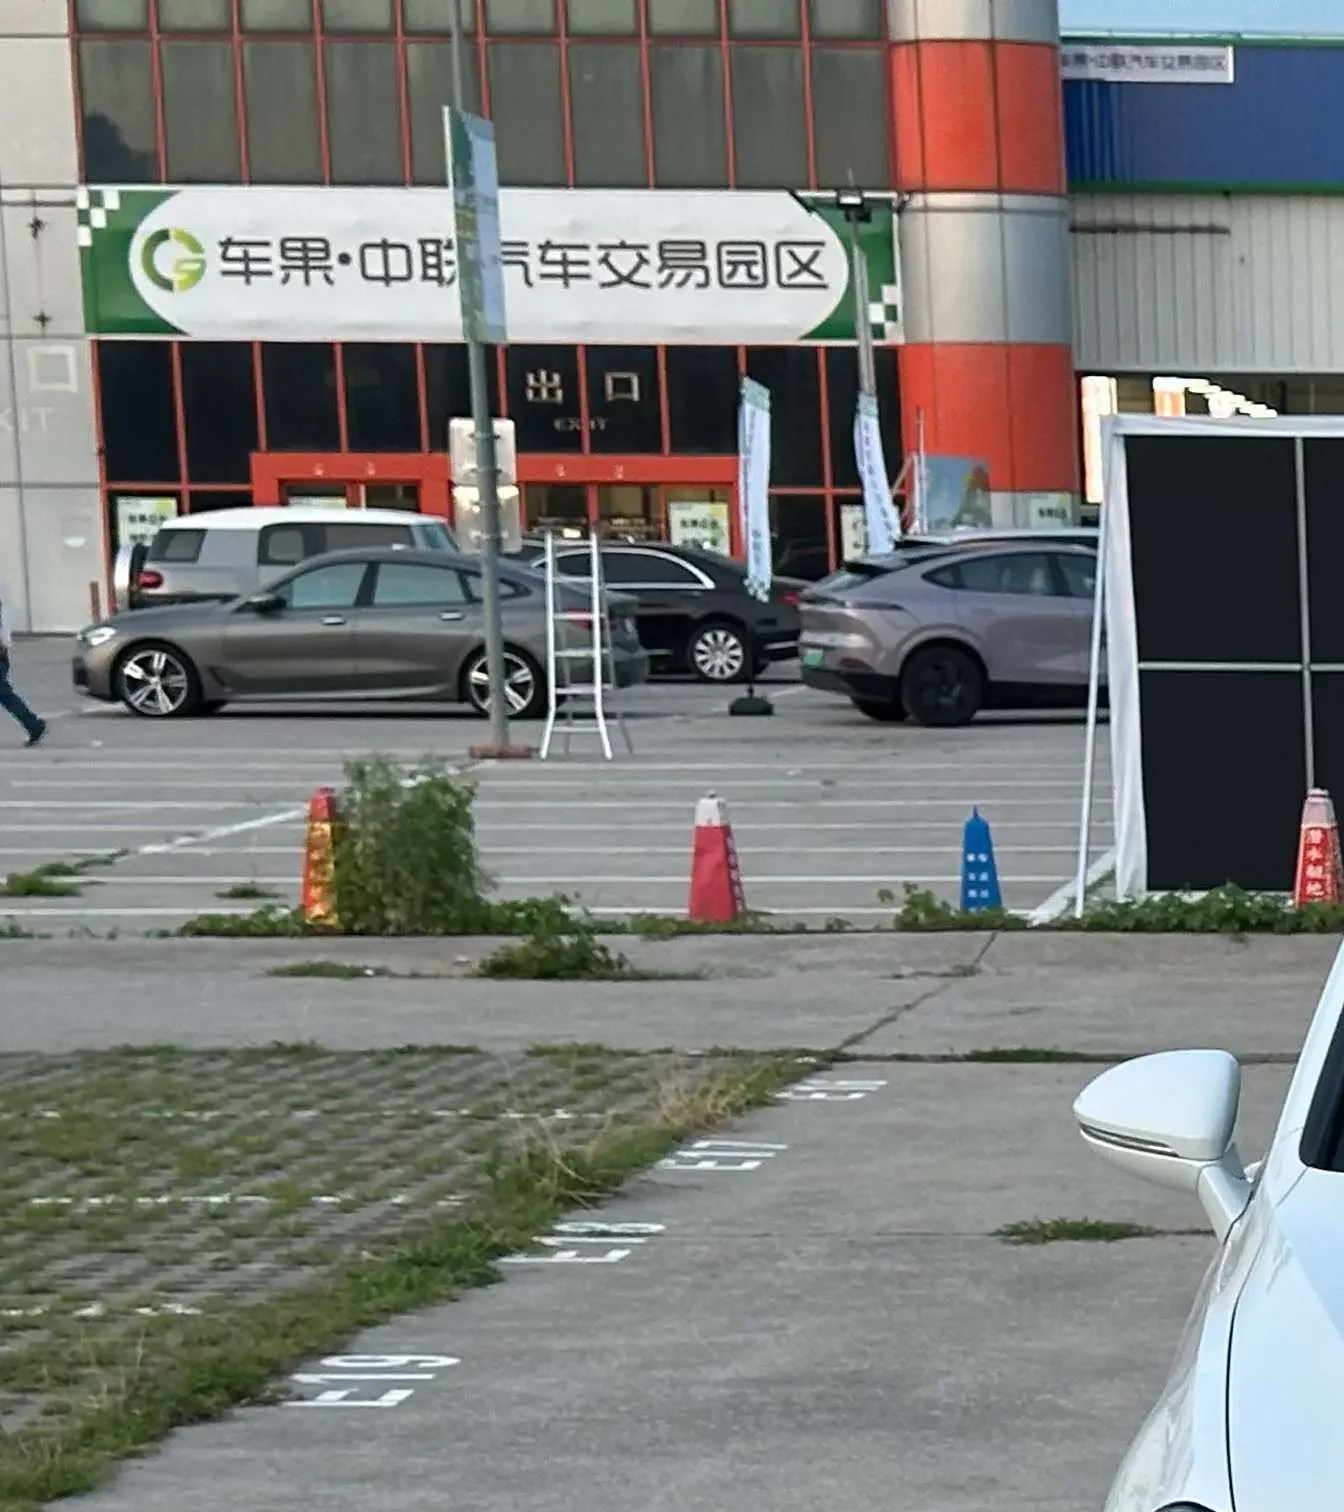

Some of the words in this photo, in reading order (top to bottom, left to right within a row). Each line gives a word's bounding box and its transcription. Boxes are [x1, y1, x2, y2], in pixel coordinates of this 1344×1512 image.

[526, 369, 642, 404] 出口
[553, 417, 609, 432] EXIT
[498, 1222, 666, 1263] E18
[281, 1355, 461, 1407] E19
